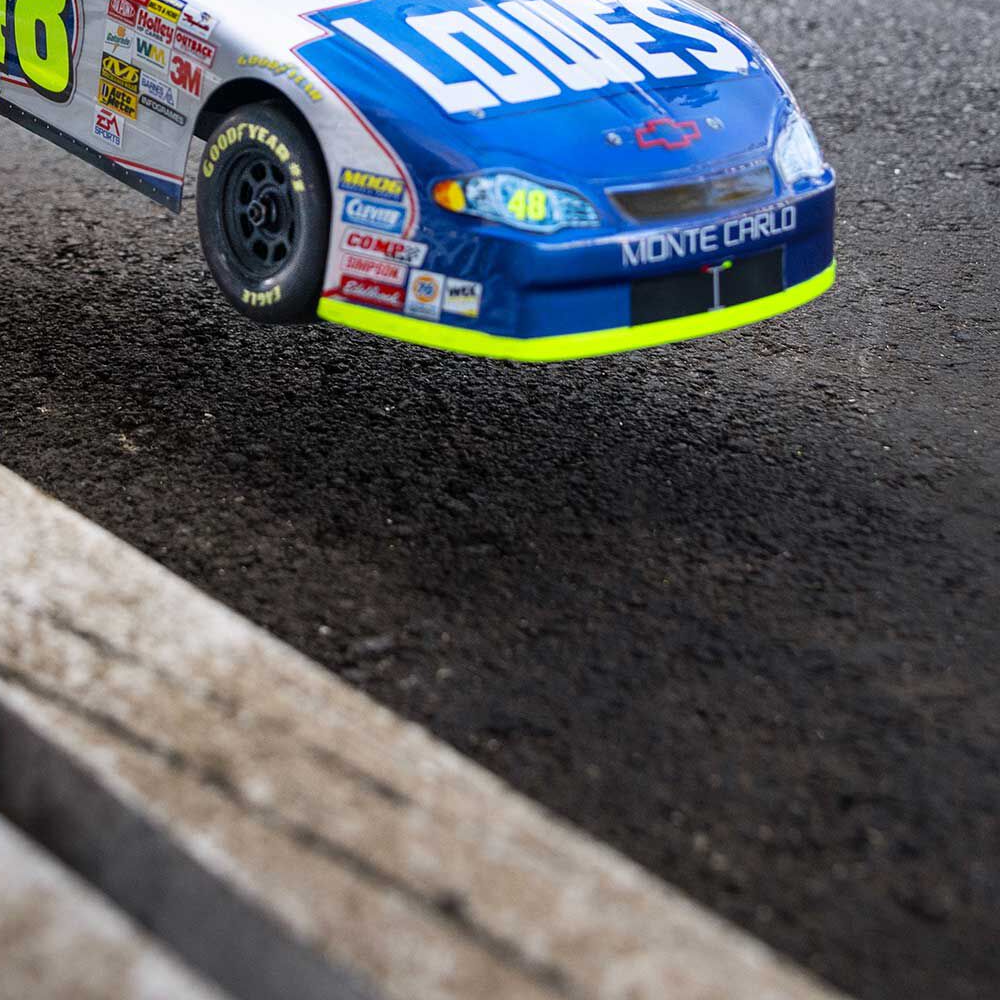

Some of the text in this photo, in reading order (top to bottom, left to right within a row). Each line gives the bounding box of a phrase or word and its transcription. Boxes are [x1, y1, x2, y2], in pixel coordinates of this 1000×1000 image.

[138, 9, 174, 44] Holley
[176, 34, 212, 57] OUTBACK
[170, 55, 201, 96] 3M
[94, 125, 120, 146] SPORTS
[202, 123, 290, 178] GOODYEAR
[508, 188, 546, 221] 48
[347, 233, 404, 258] COMP
[621, 206, 796, 267] MONTE CARLO
[241, 285, 282, 306] EAGLE
